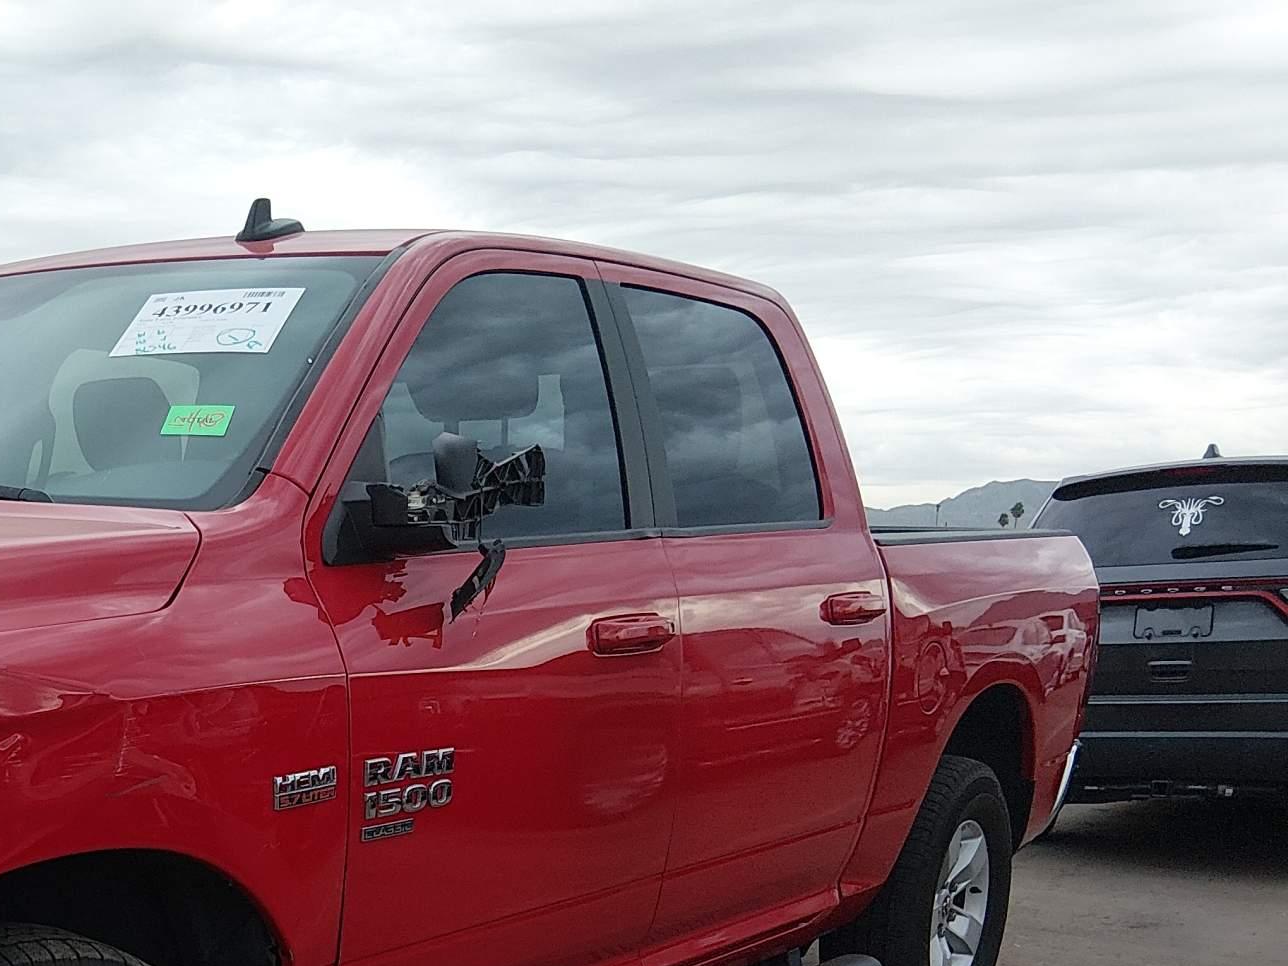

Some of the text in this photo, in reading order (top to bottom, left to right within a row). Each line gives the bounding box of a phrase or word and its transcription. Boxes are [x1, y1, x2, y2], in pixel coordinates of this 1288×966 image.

[151, 301, 273, 318] 43996971
[274, 766, 337, 795] HEMI
[363, 747, 455, 787] RAM
[363, 779, 453, 820] 1500
[363, 819, 414, 840] CLASSIC
